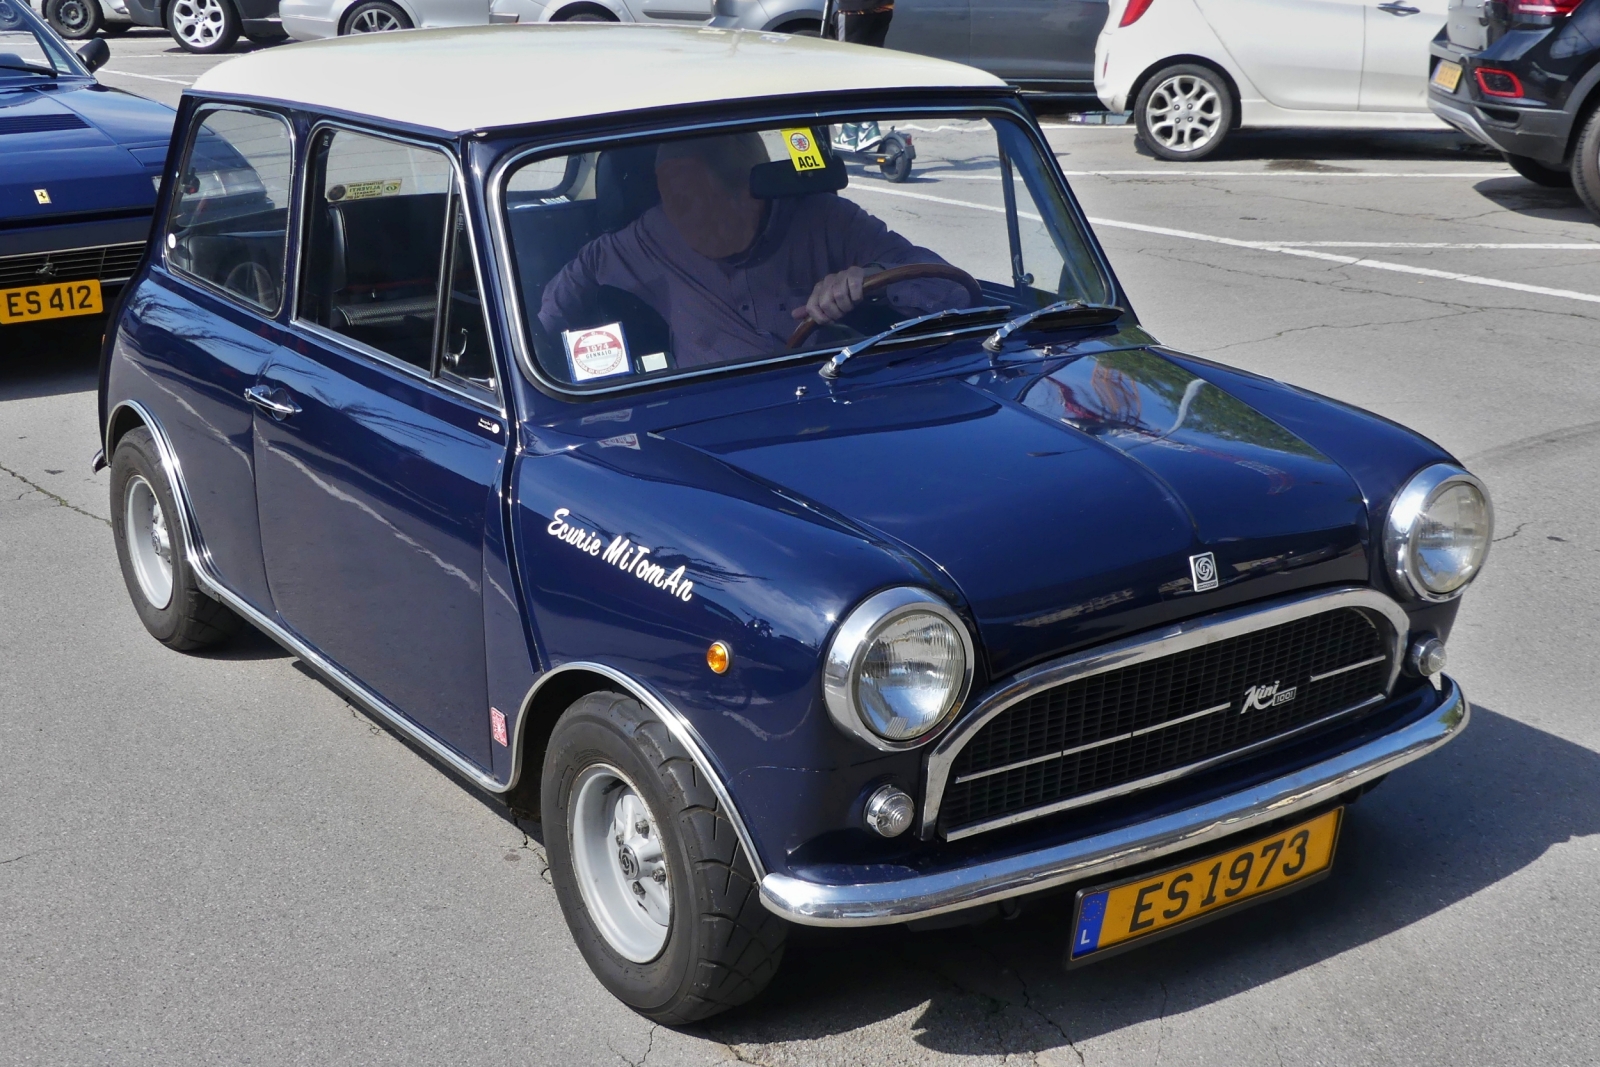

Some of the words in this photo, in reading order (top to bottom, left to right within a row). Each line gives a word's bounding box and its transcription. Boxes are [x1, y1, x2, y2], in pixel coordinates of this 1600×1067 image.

[798, 155, 820, 169] ACL
[6, 291, 42, 317] ES
[49, 285, 93, 311] 412
[585, 350, 612, 359] GENNAIO
[547, 508, 601, 556] Ecurie
[602, 535, 694, 602] MiTomAn
[1240, 680, 1281, 714] Mini
[1277, 690, 1293, 703] 1001
[1128, 829, 1310, 933] ES1973
[1080, 929, 1090, 945] L
